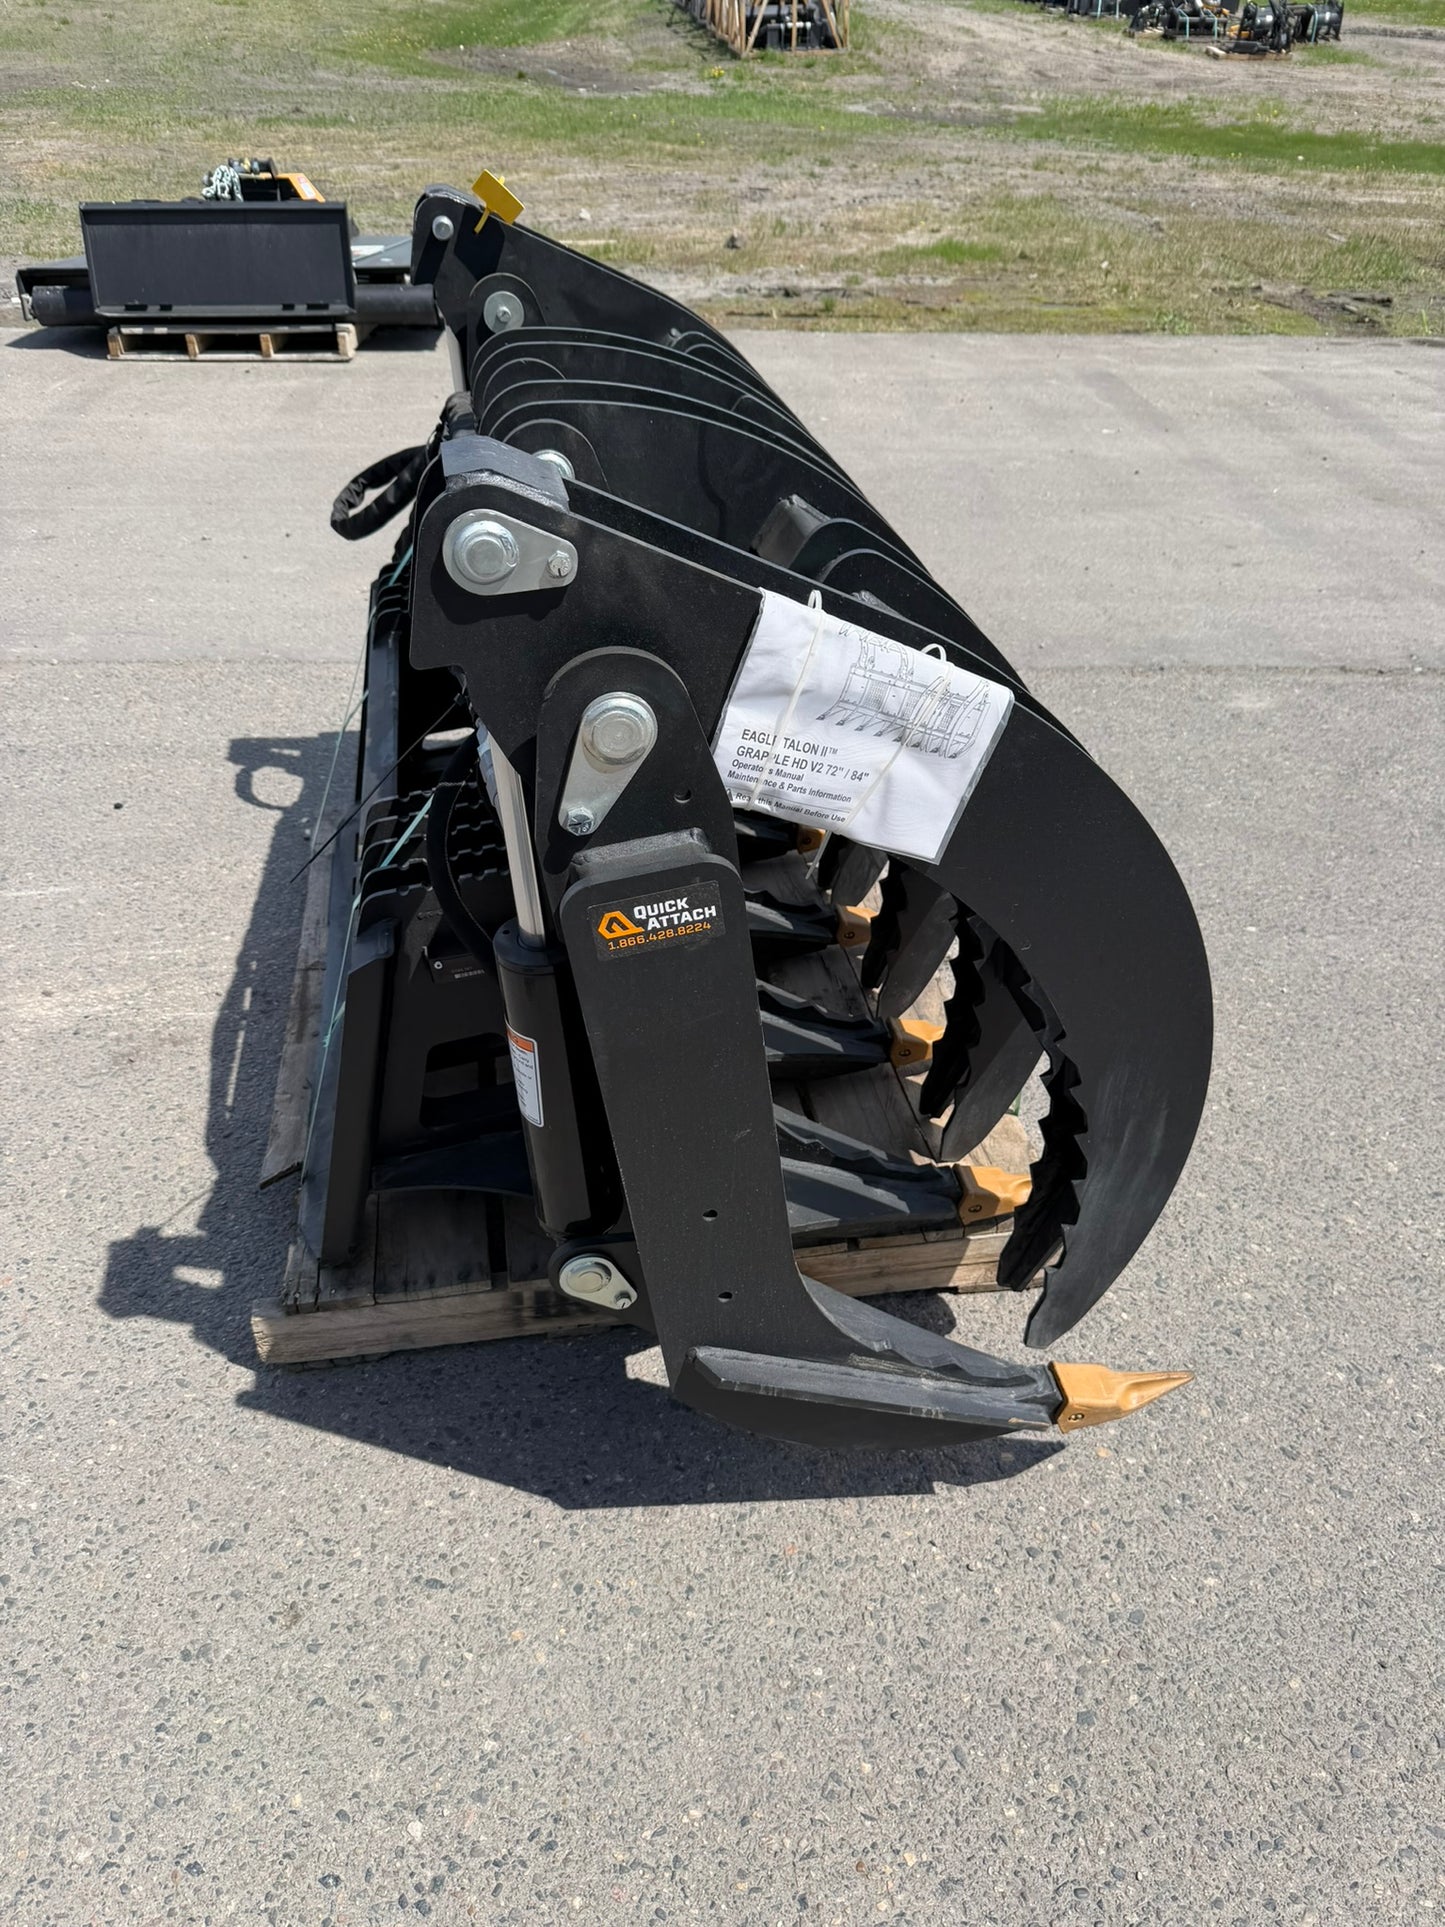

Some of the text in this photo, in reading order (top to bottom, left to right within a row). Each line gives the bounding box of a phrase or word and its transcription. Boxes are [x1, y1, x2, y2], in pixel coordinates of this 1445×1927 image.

[741, 728, 779, 747] EAGL
[783, 737, 819, 756] TALON
[732, 759, 805, 782] Operatos Manual
[736, 745, 791, 767] GRAPLE
[791, 757, 808, 770] HD
[811, 761, 825, 774] V2
[825, 764, 844, 777] 72"
[850, 770, 870, 782] 84"
[727, 770, 852, 803] Maintennce & Parts Information
[735, 792, 846, 823] Rea this Manual Before Use
[633, 897, 689, 920] QUICK
[647, 905, 717, 931] ATTACH
[608, 921, 712, 951] 1.866.428.8224
